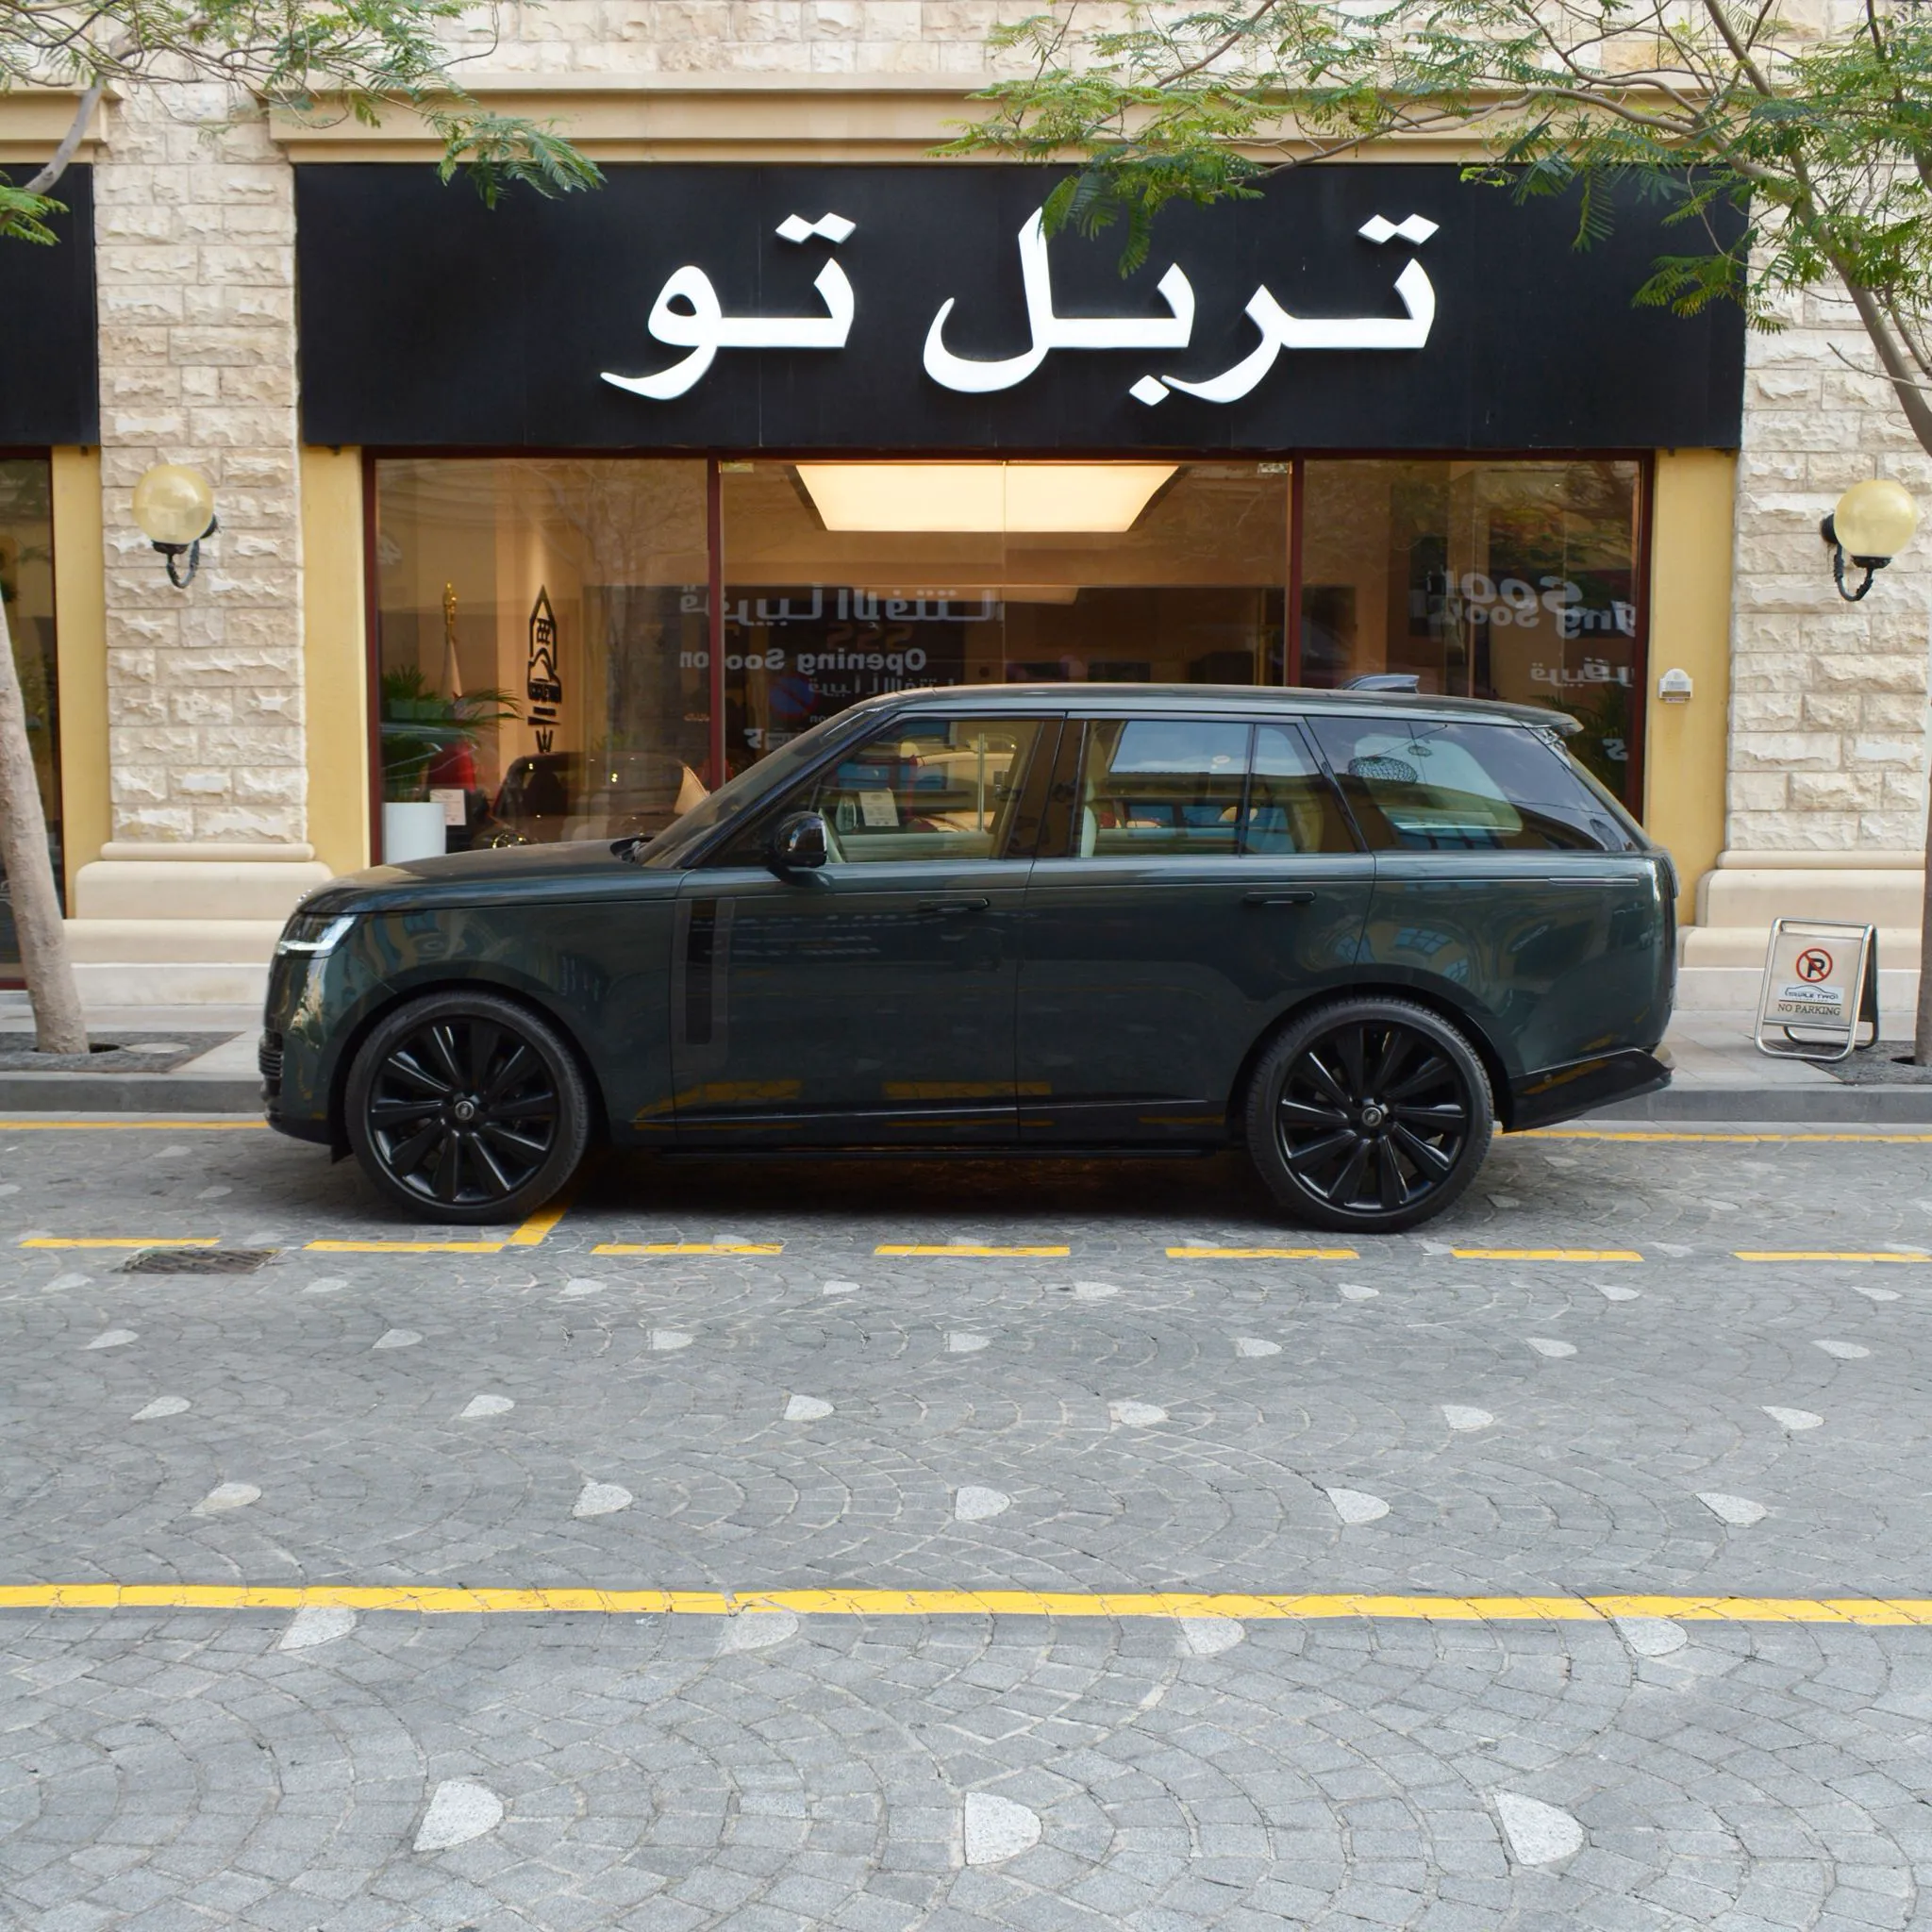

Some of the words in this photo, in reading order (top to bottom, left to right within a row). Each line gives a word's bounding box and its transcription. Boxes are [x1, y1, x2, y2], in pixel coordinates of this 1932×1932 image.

[600, 212, 858, 400] تو
[1777, 1003, 1792, 1012] NO
[1794, 1004, 1841, 1016] PARKING
